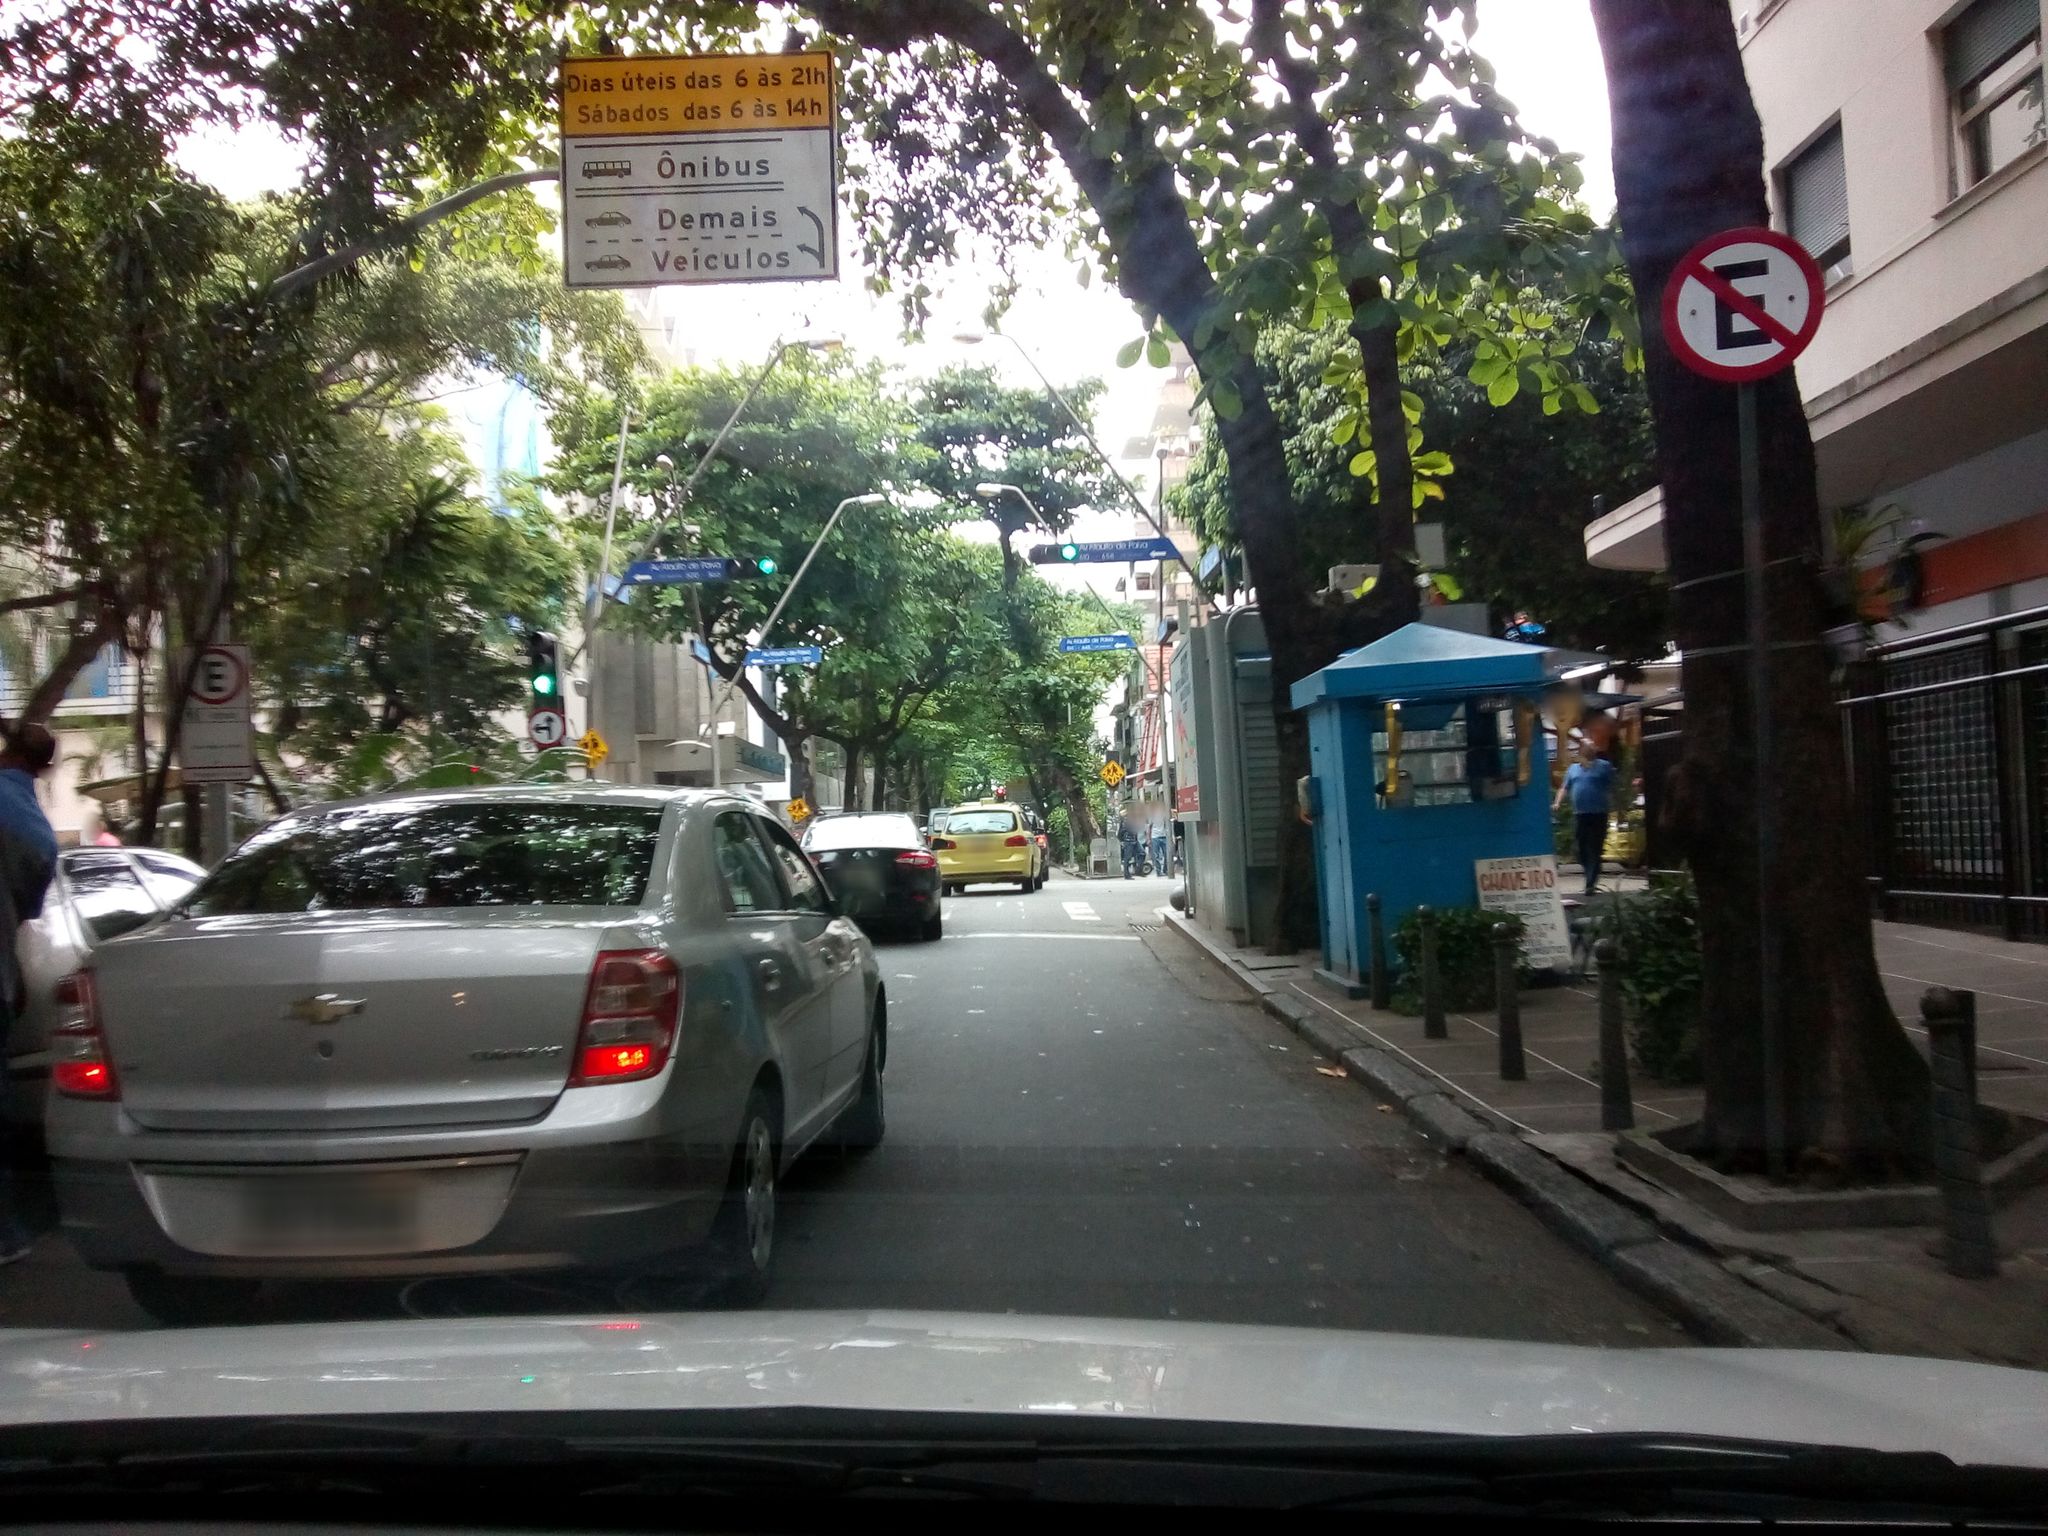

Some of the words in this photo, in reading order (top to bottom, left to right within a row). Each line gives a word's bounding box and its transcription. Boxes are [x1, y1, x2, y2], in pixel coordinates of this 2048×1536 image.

[567, 74, 614, 93] Dias
[622, 71, 676, 91] úteis
[685, 71, 722, 89] das
[735, 68, 748, 88] 6
[758, 67, 781, 87] às
[791, 66, 825, 86] 21h
[577, 103, 669, 124] Sábados
[684, 102, 721, 120] das
[730, 100, 743, 119] 6
[752, 97, 777, 117] às
[786, 97, 822, 117] 14h
[657, 150, 770, 179] Ônibus
[658, 206, 777, 230] Demais
[651, 247, 790, 272] Veículos
[1713, 259, 1772, 350] E
[206, 661, 225, 693] E
[1480, 869, 1554, 892] CHAVEIRO
